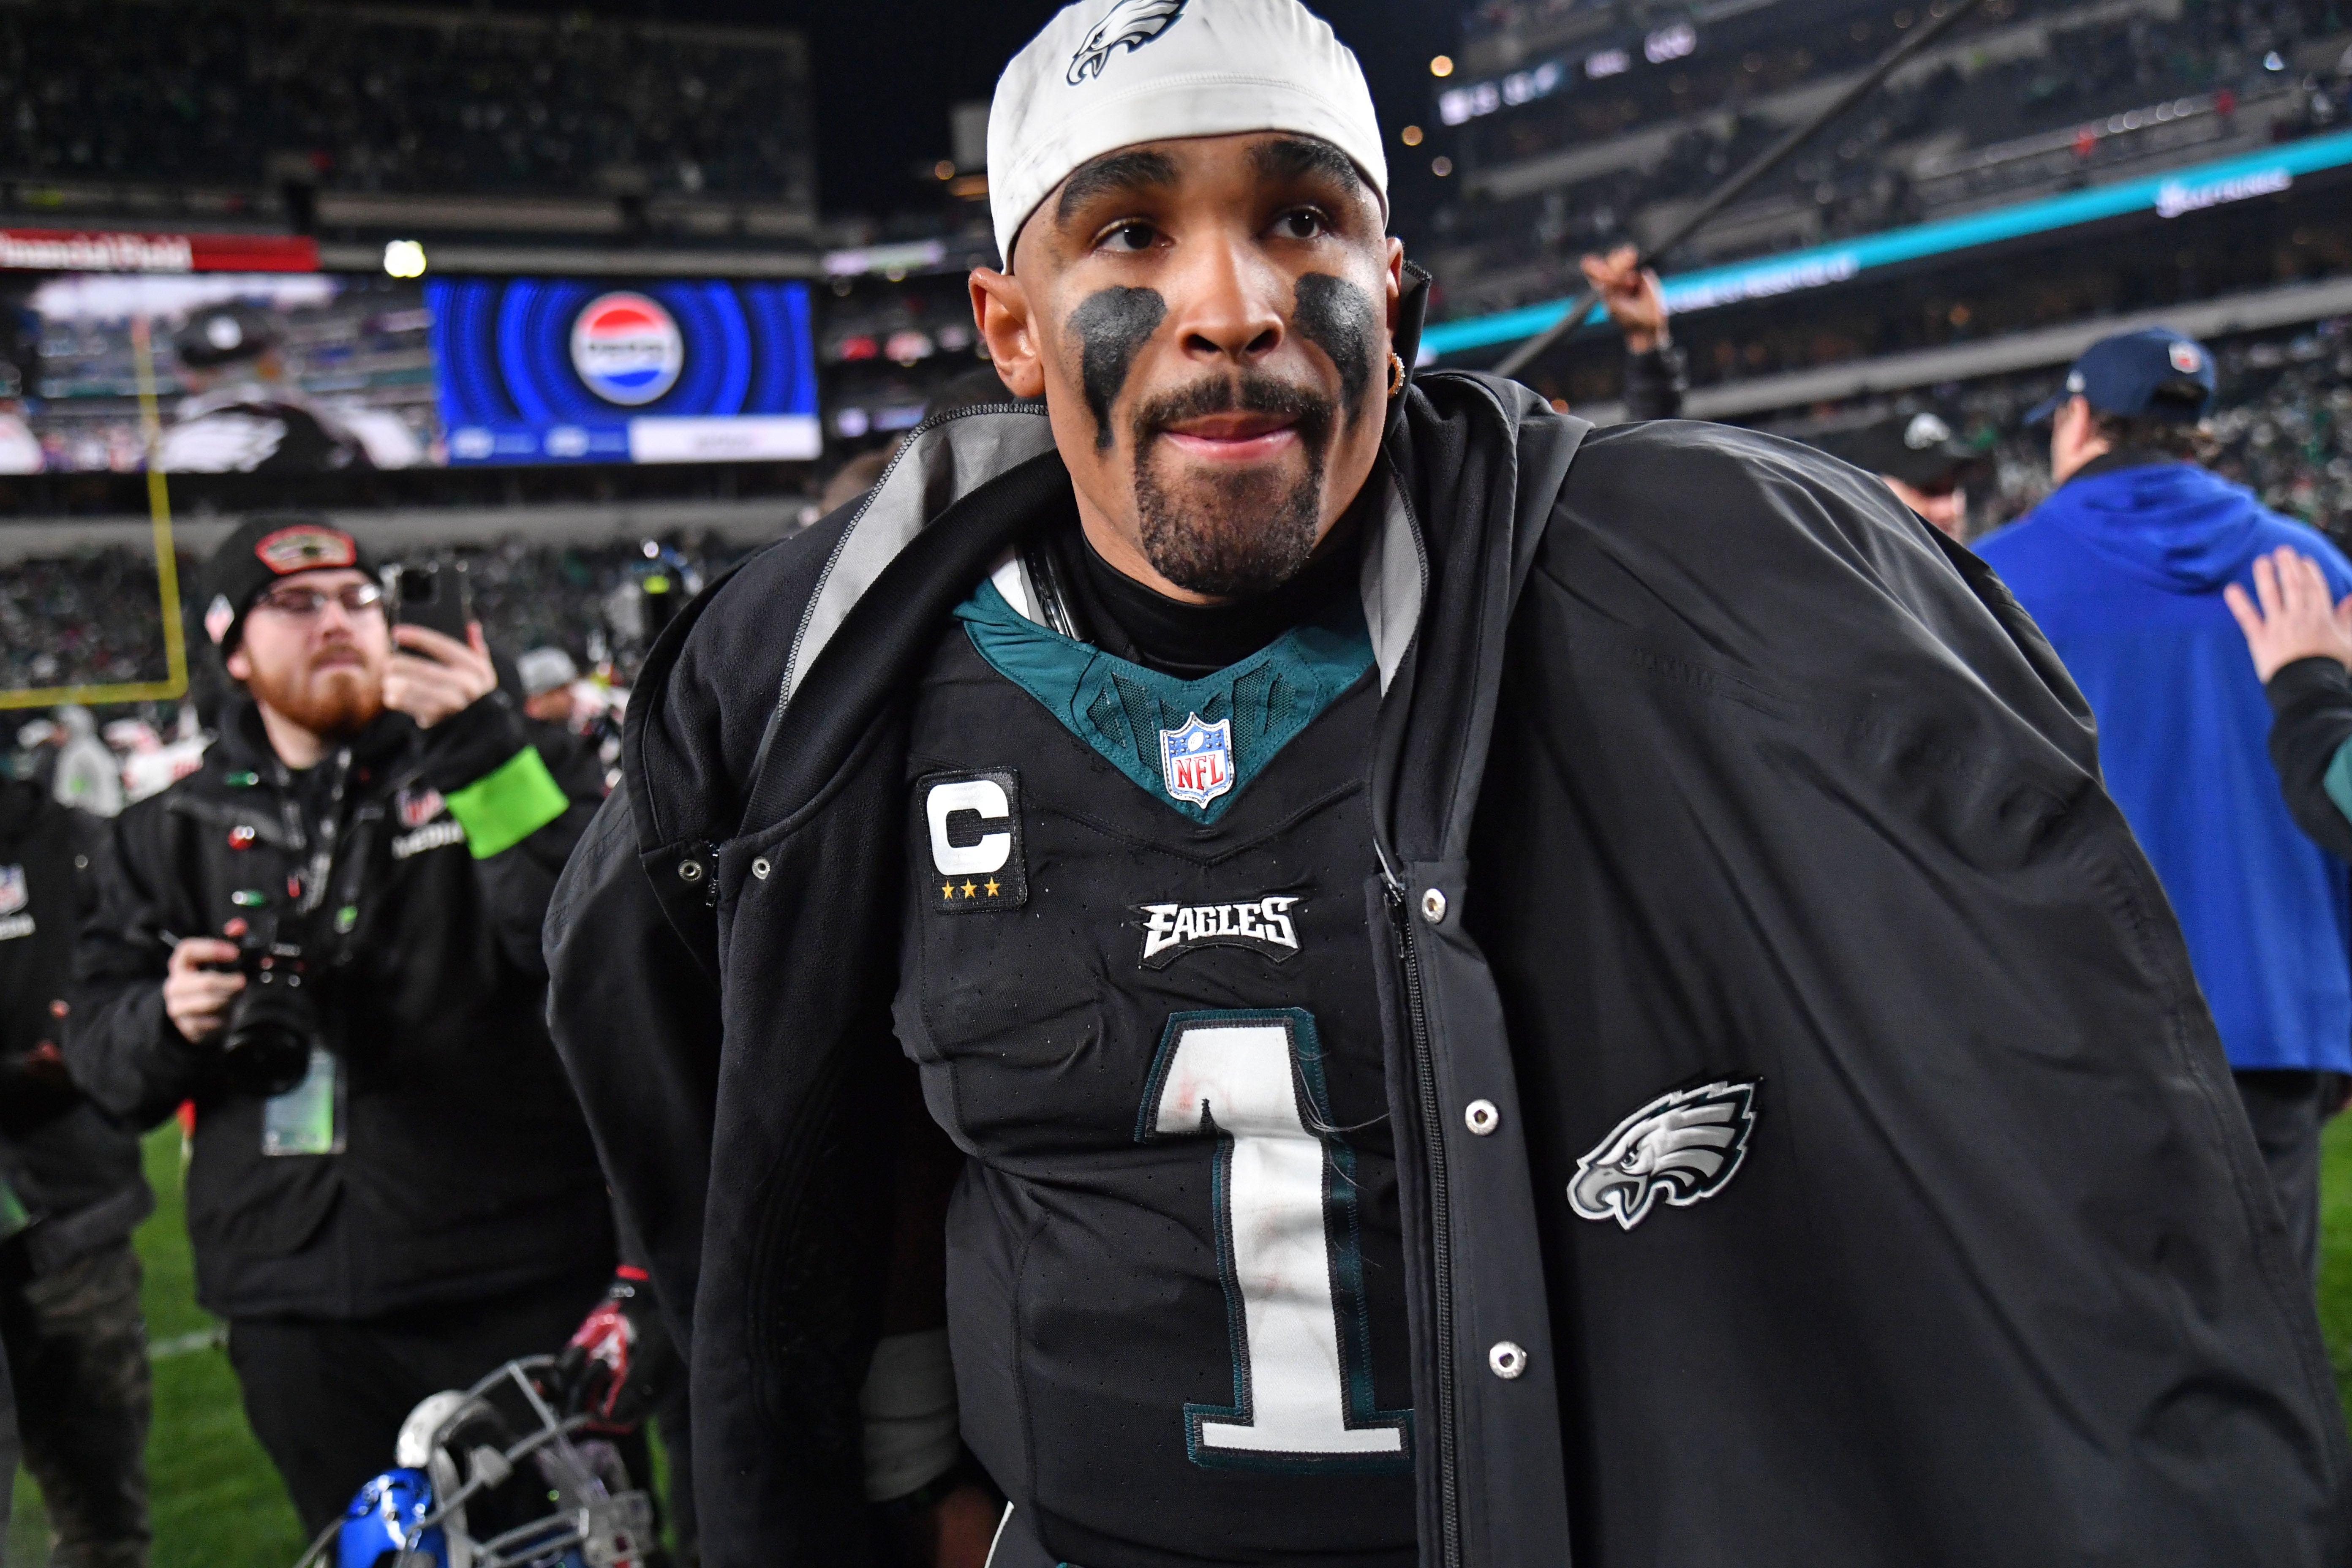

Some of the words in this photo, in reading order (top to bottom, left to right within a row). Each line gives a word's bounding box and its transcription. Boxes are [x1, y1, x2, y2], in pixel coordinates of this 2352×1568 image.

[1175, 754, 1224, 790] NFL
[927, 780, 1010, 875] C
[1140, 897, 1299, 958] EAGLES
[1153, 1024, 1403, 1453] 1
